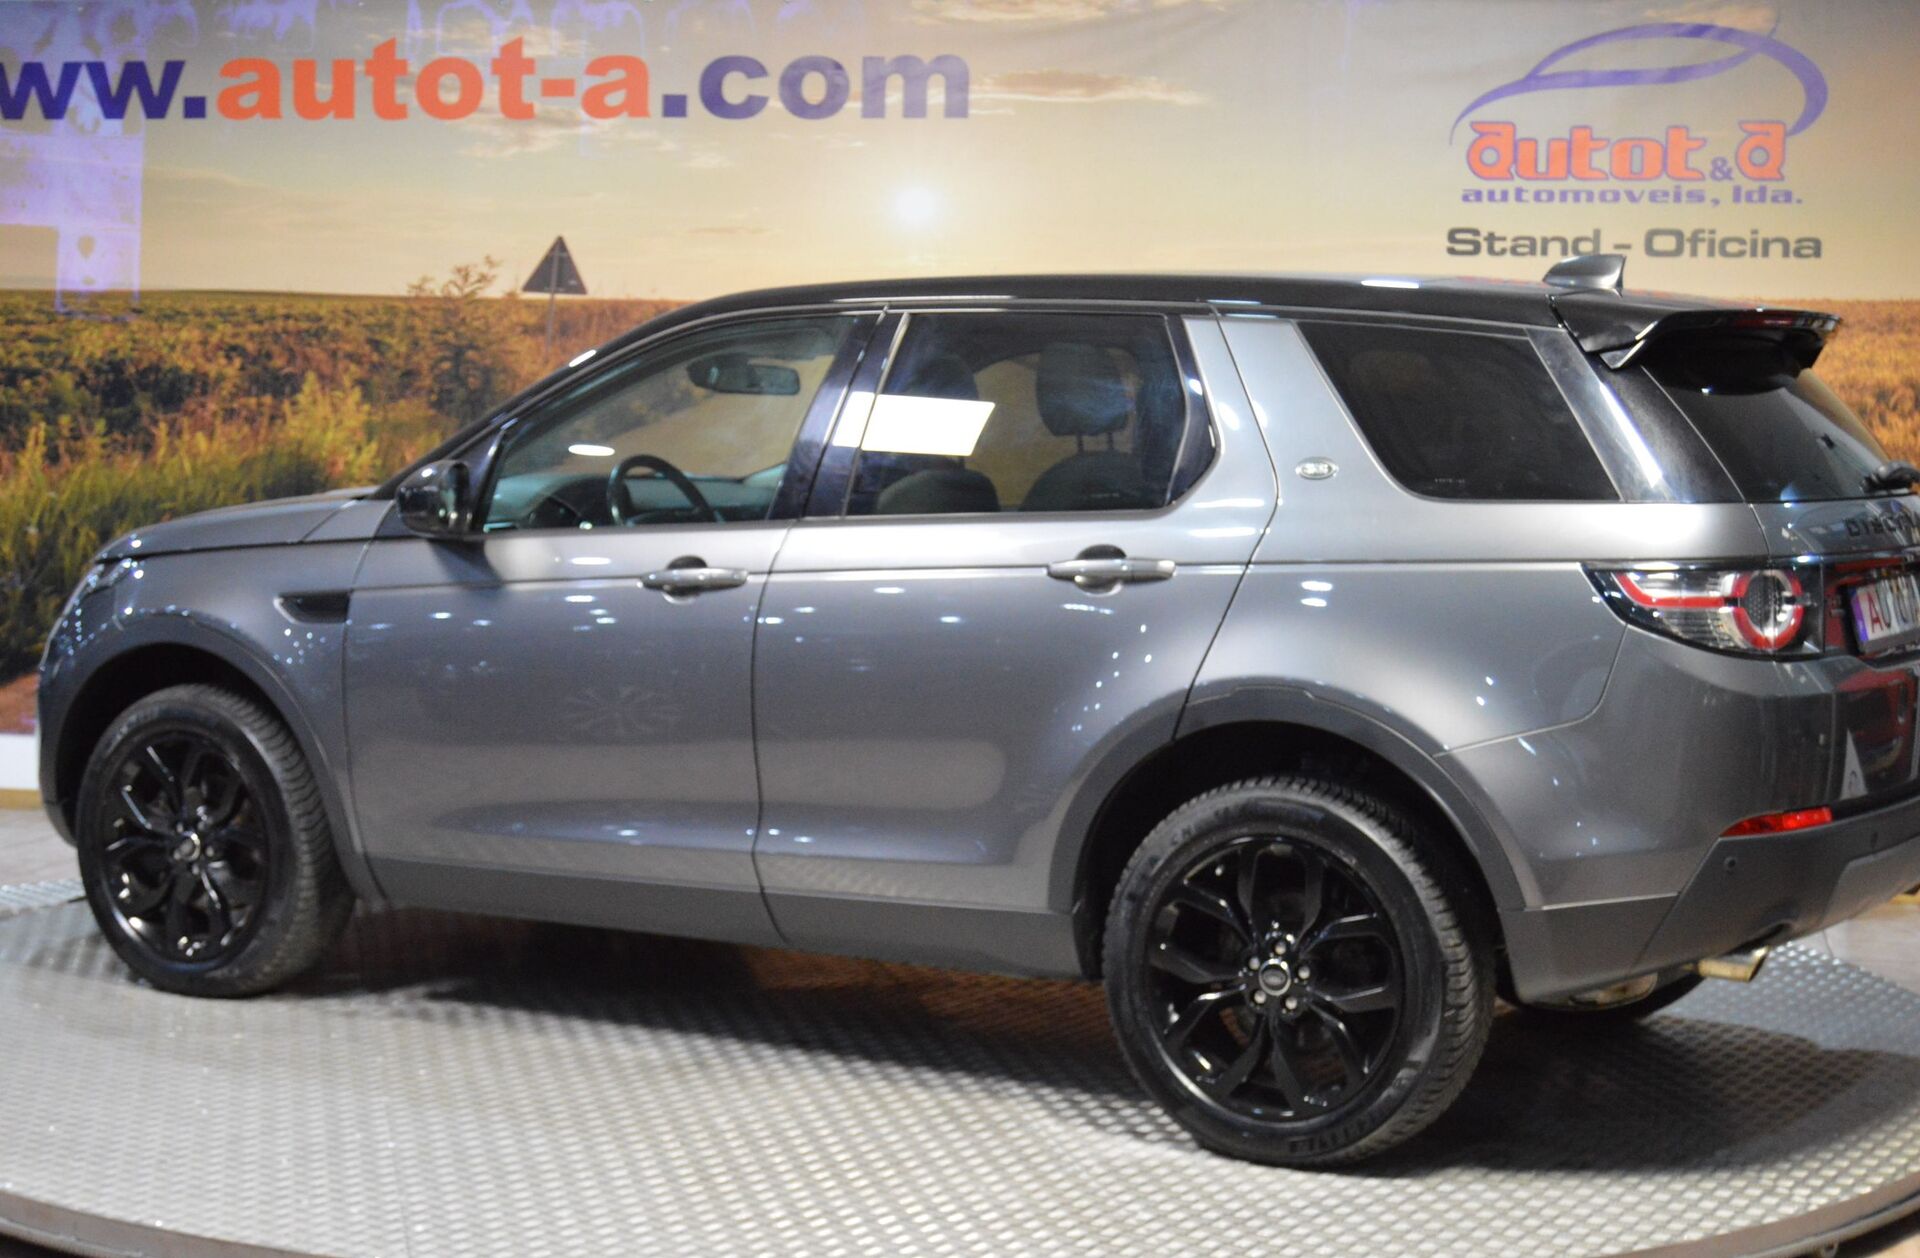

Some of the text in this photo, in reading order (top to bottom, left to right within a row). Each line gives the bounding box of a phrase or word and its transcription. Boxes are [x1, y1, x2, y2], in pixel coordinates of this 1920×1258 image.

[1461, 186, 1803, 206] automoveis, lda.
[1446, 227, 1601, 258] Stand
[1644, 228, 1822, 258] Oficina
